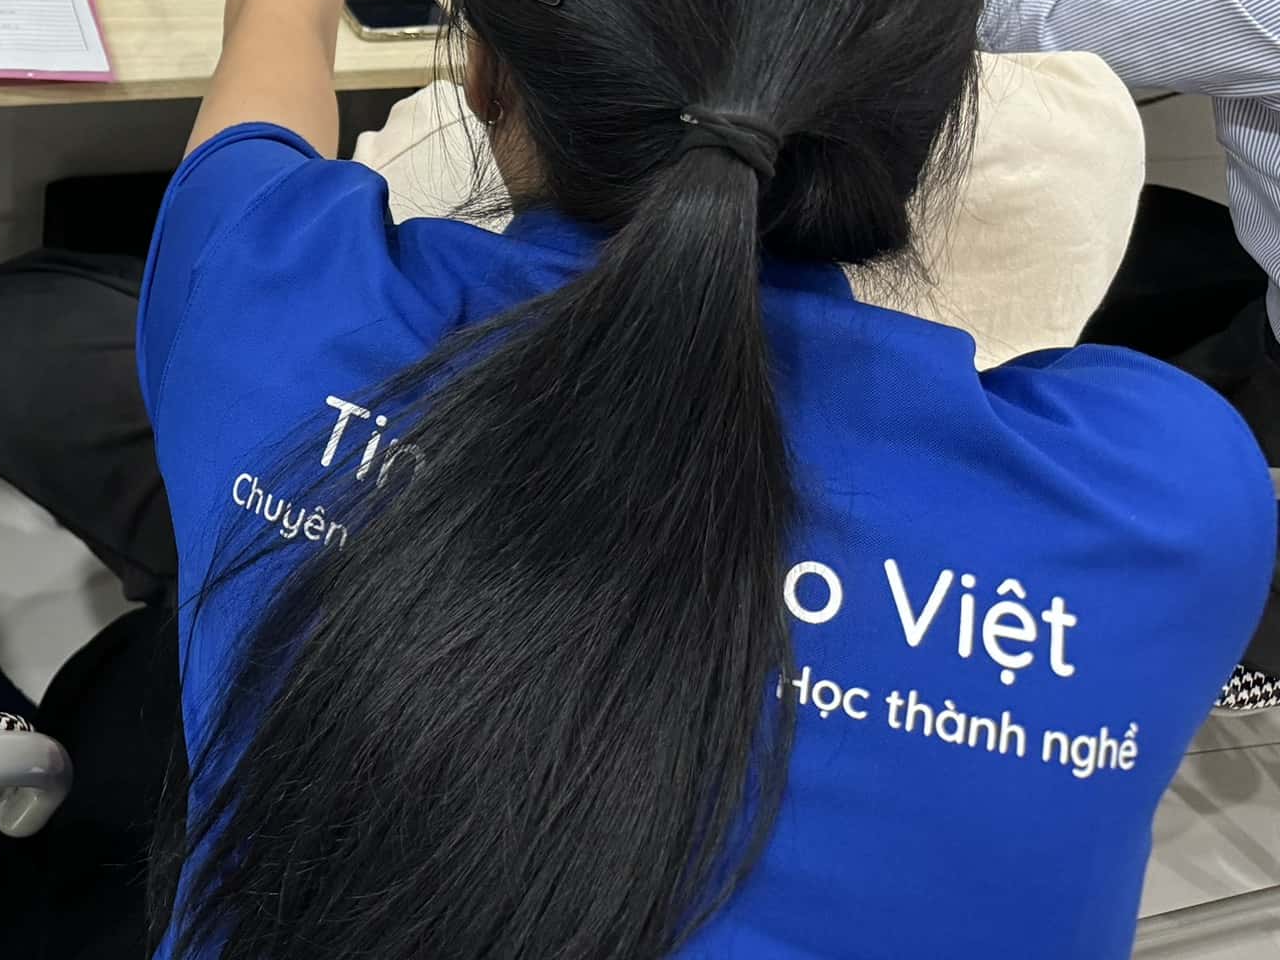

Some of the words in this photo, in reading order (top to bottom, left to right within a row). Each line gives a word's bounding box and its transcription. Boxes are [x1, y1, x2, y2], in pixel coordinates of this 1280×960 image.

[232, 472, 349, 551] Chuyên
[776, 665, 870, 720] Học
[885, 689, 1026, 758] thành
[1041, 722, 1139, 779] nghề
[884, 558, 1078, 685] Việt
